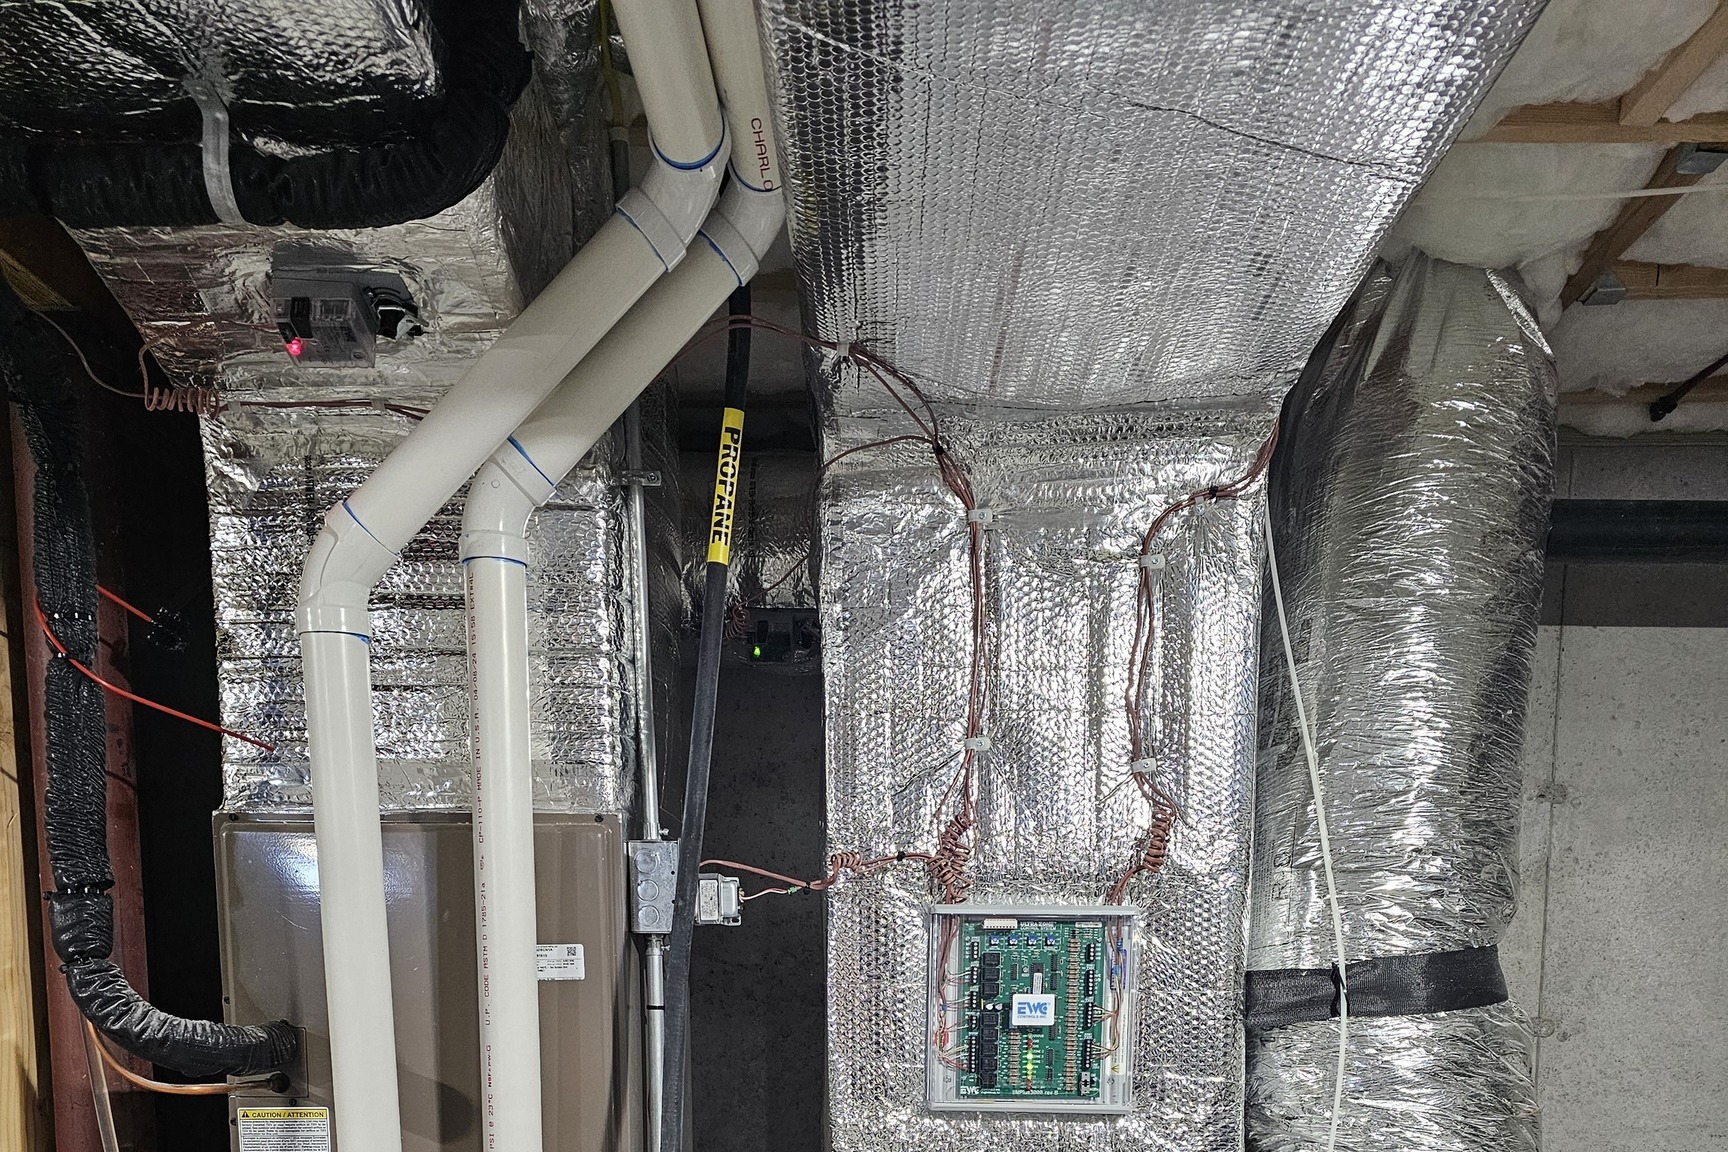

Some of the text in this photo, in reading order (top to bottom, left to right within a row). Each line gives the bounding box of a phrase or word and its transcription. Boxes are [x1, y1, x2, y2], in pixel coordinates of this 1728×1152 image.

[711, 426, 741, 546] PROPANE
[475, 748, 481, 759] IN
[1017, 1002, 1047, 1015] EWC
[960, 1086, 979, 1094] EWC
